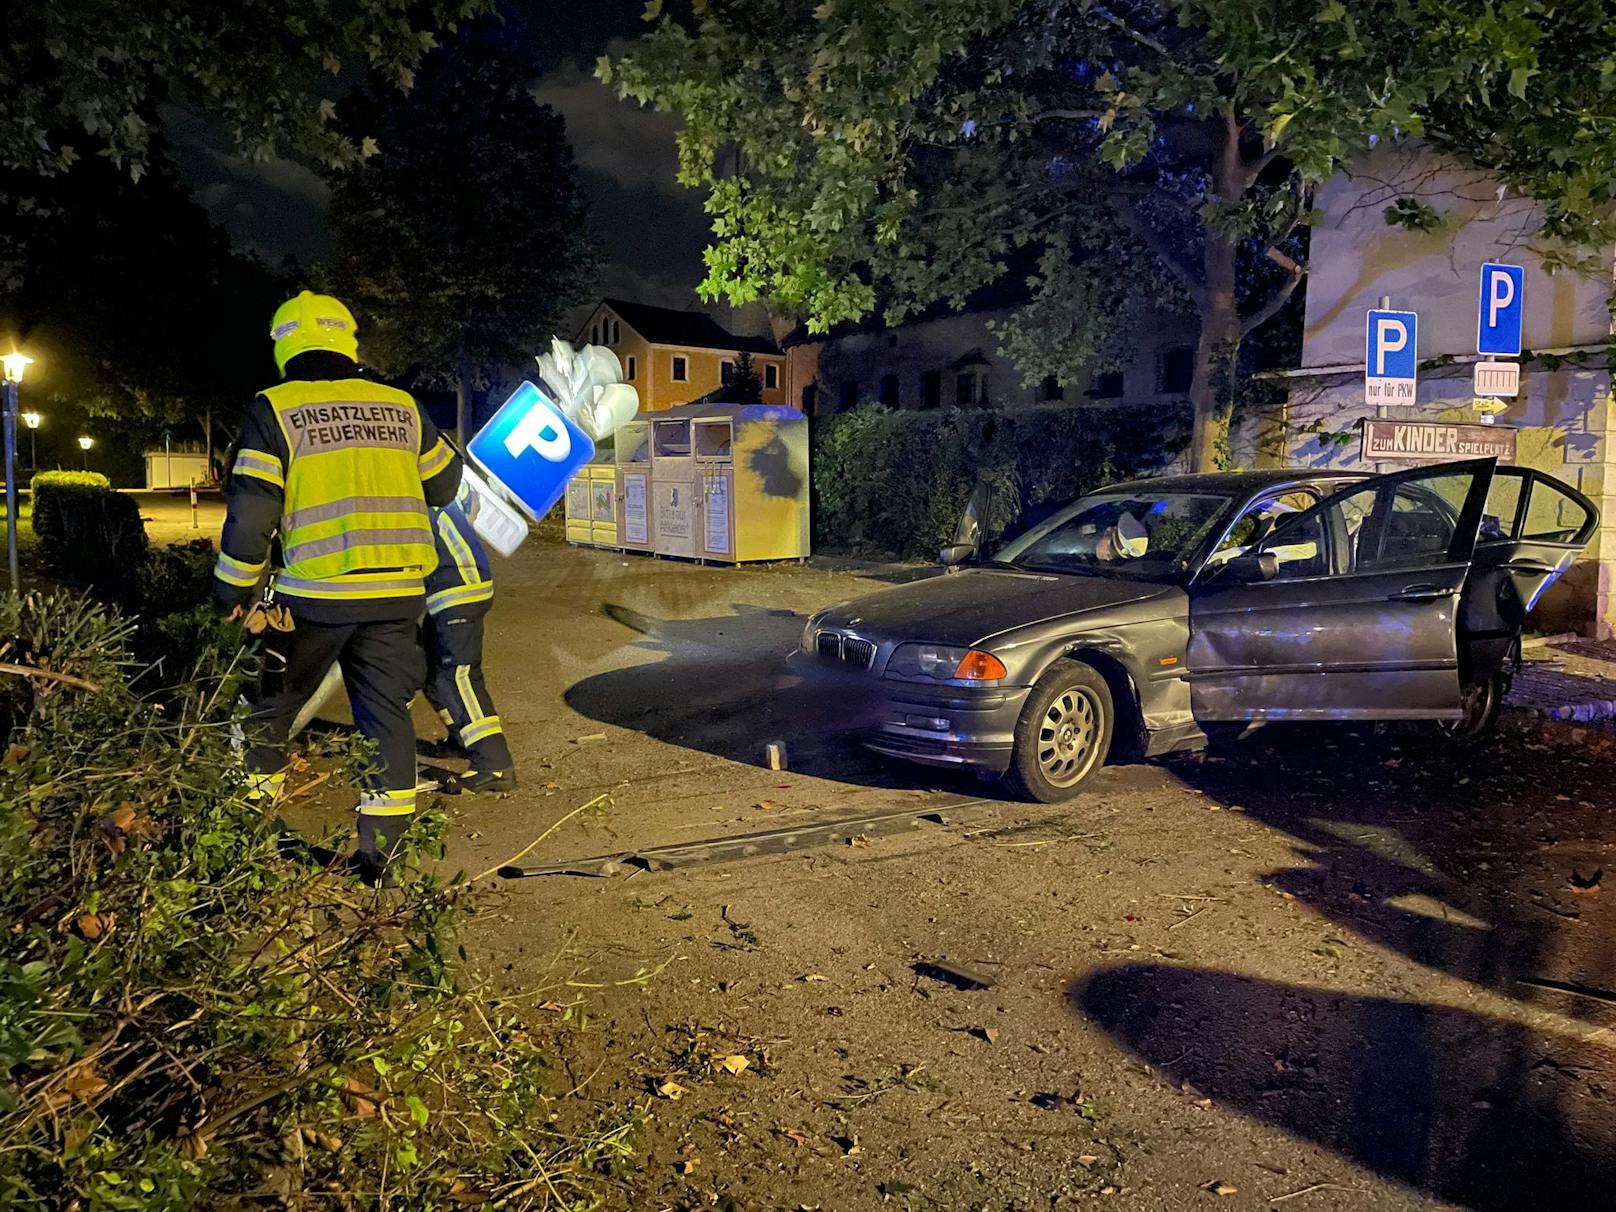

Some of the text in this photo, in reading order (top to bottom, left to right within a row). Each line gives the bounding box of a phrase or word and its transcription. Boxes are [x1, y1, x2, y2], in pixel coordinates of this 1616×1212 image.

[1489, 270, 1514, 327] P
[1377, 319, 1407, 374] P
[1368, 382, 1414, 398] nur für PKW
[290, 406, 413, 429] EINSATZLEITER
[503, 399, 571, 462] P
[308, 424, 408, 445] FEUERWEHR
[1372, 438, 1394, 451] ZUM
[1393, 425, 1459, 453] KINDER
